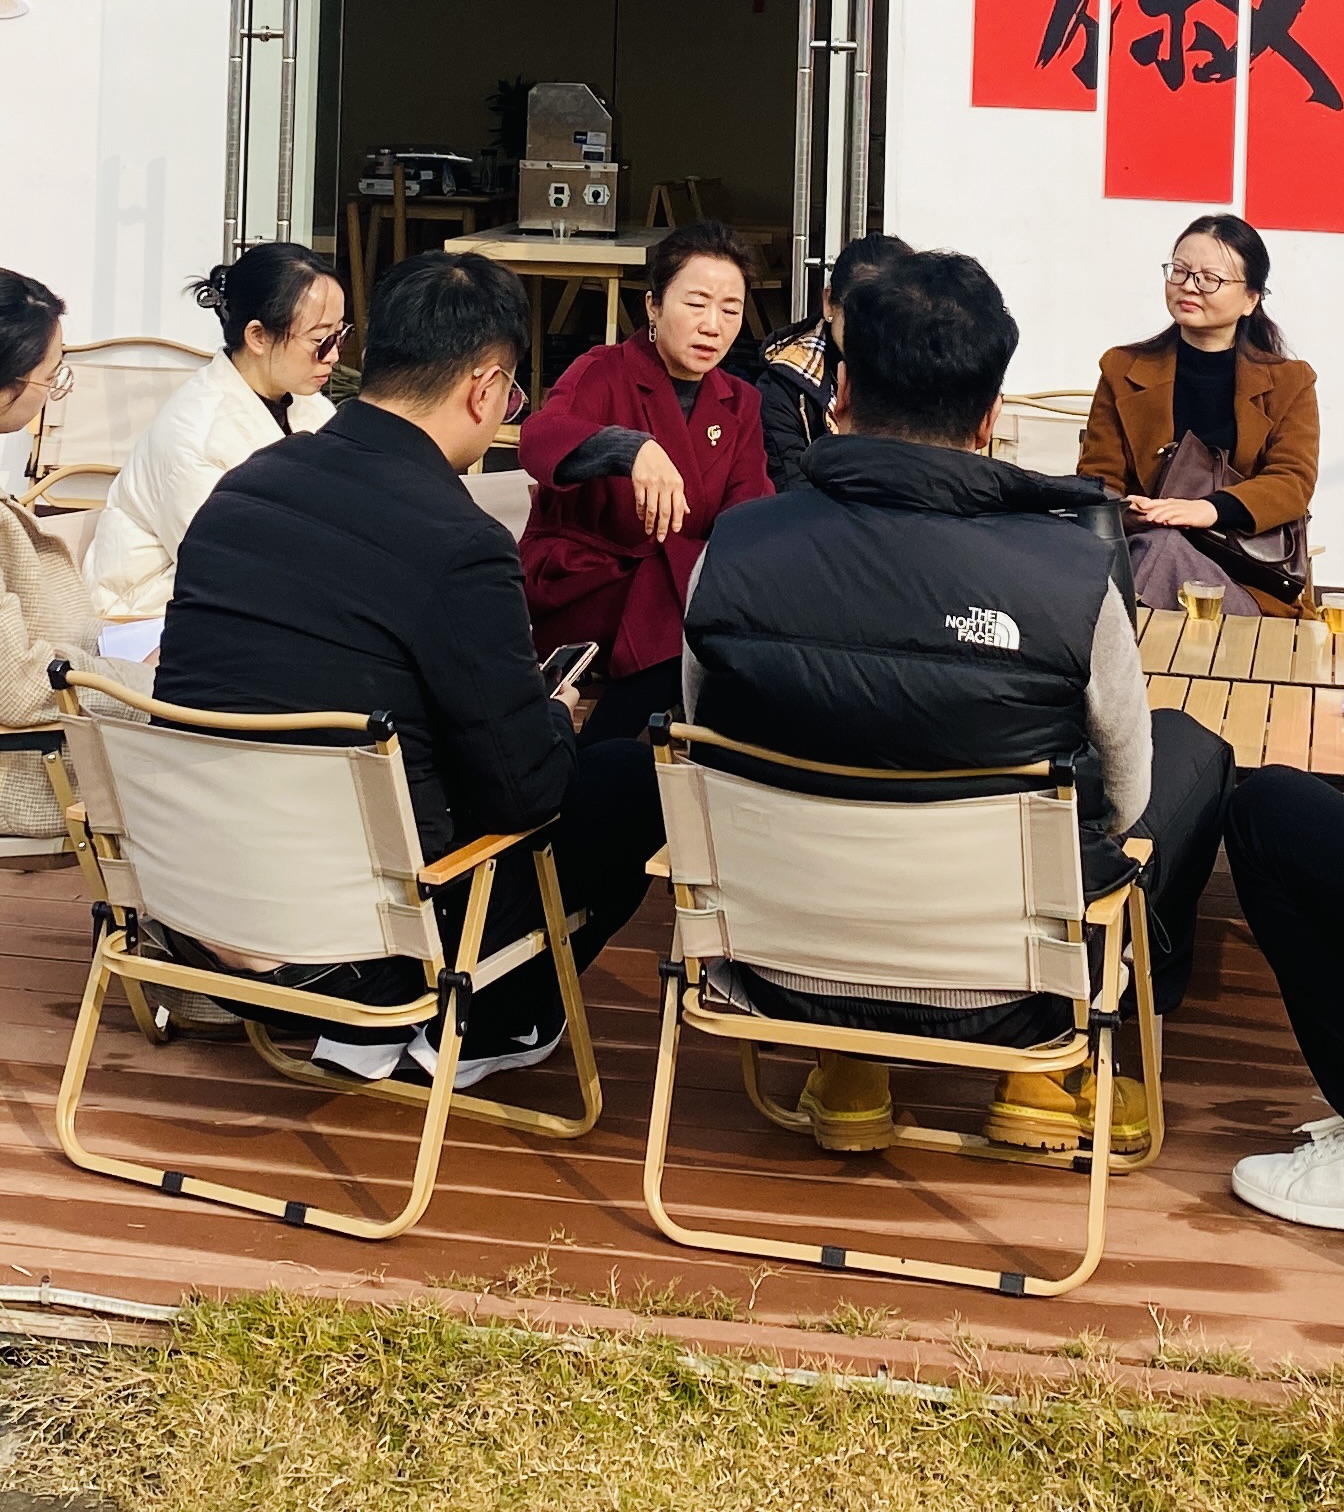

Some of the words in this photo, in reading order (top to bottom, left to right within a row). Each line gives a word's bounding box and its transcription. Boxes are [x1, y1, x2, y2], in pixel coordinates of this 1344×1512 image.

[968, 606, 997, 621] THE
[945, 614, 996, 635] NORTH
[957, 628, 995, 645] FACE
